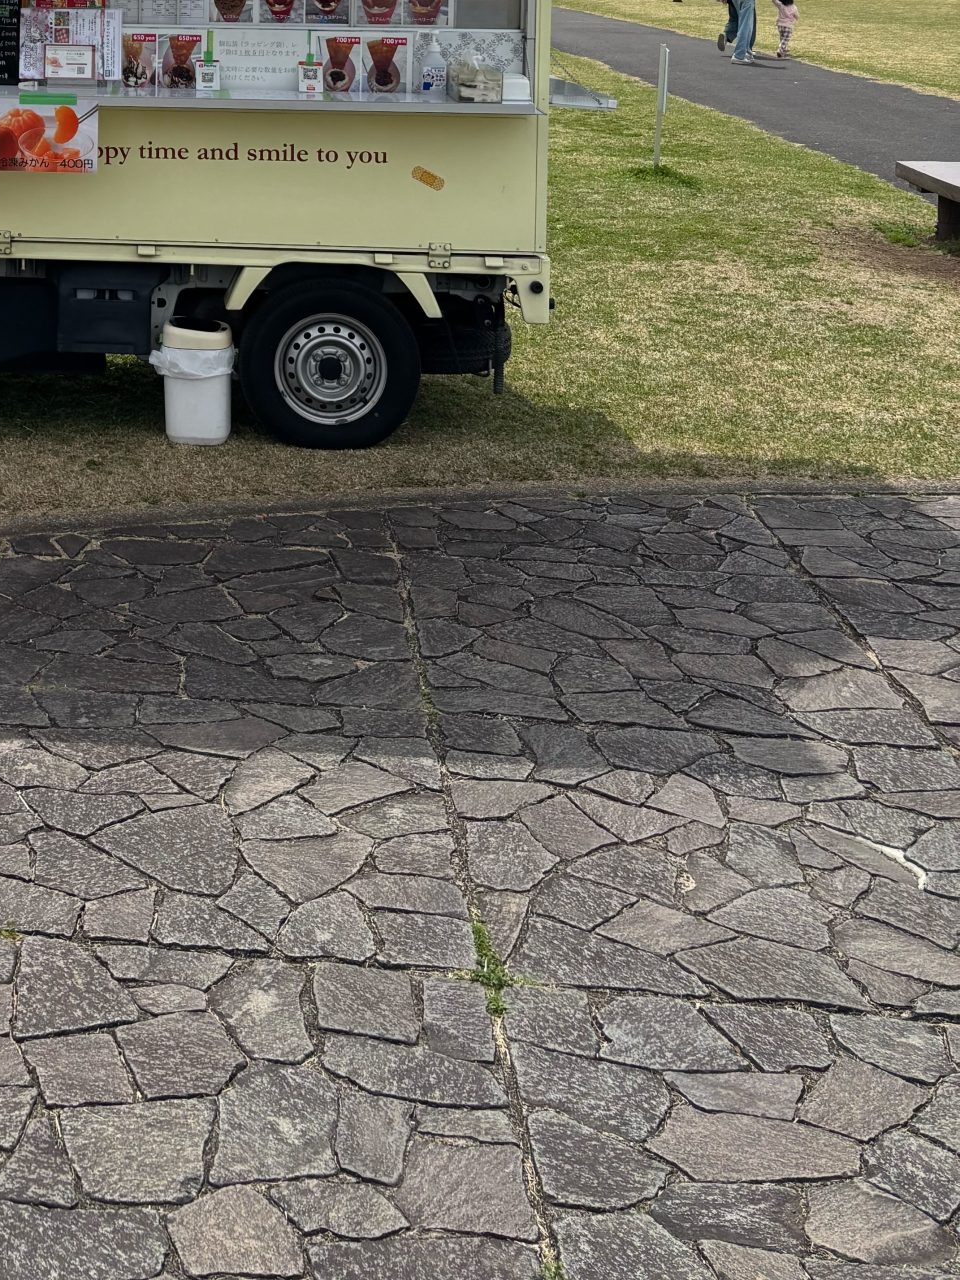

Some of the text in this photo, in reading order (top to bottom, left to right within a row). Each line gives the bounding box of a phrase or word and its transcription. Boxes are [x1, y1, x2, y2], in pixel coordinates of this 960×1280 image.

[0, 157, 94, 169] 冷凍みかん 400円
[138, 141, 190, 160] time
[197, 142, 240, 161] and
[246, 143, 309, 162] smile
[316, 147, 339, 163] to
[345, 148, 389, 169] you
